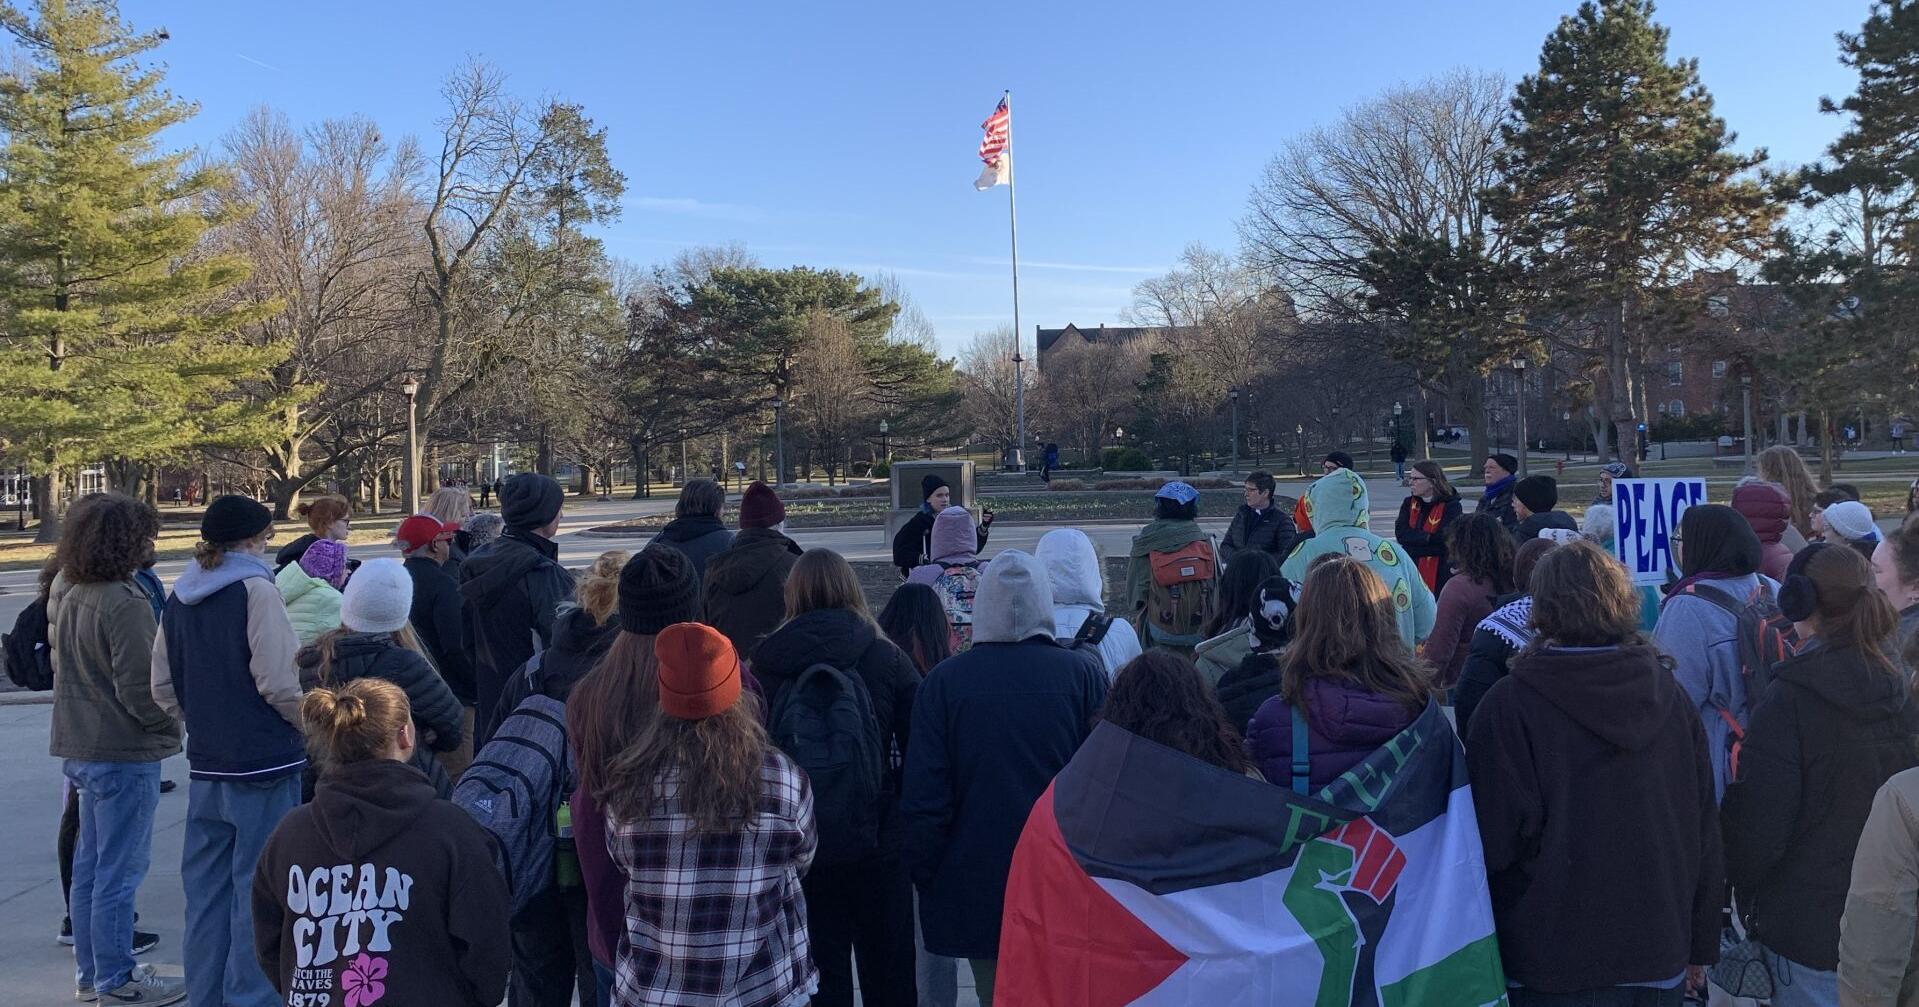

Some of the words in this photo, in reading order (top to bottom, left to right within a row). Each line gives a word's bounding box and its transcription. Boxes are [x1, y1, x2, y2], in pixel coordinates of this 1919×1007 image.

[1616, 482, 1702, 573] PEAC
[287, 863, 413, 918] OCEAN
[293, 909, 403, 969] CITY
[288, 990, 331, 1007] 1879
[314, 968, 333, 979] THE
